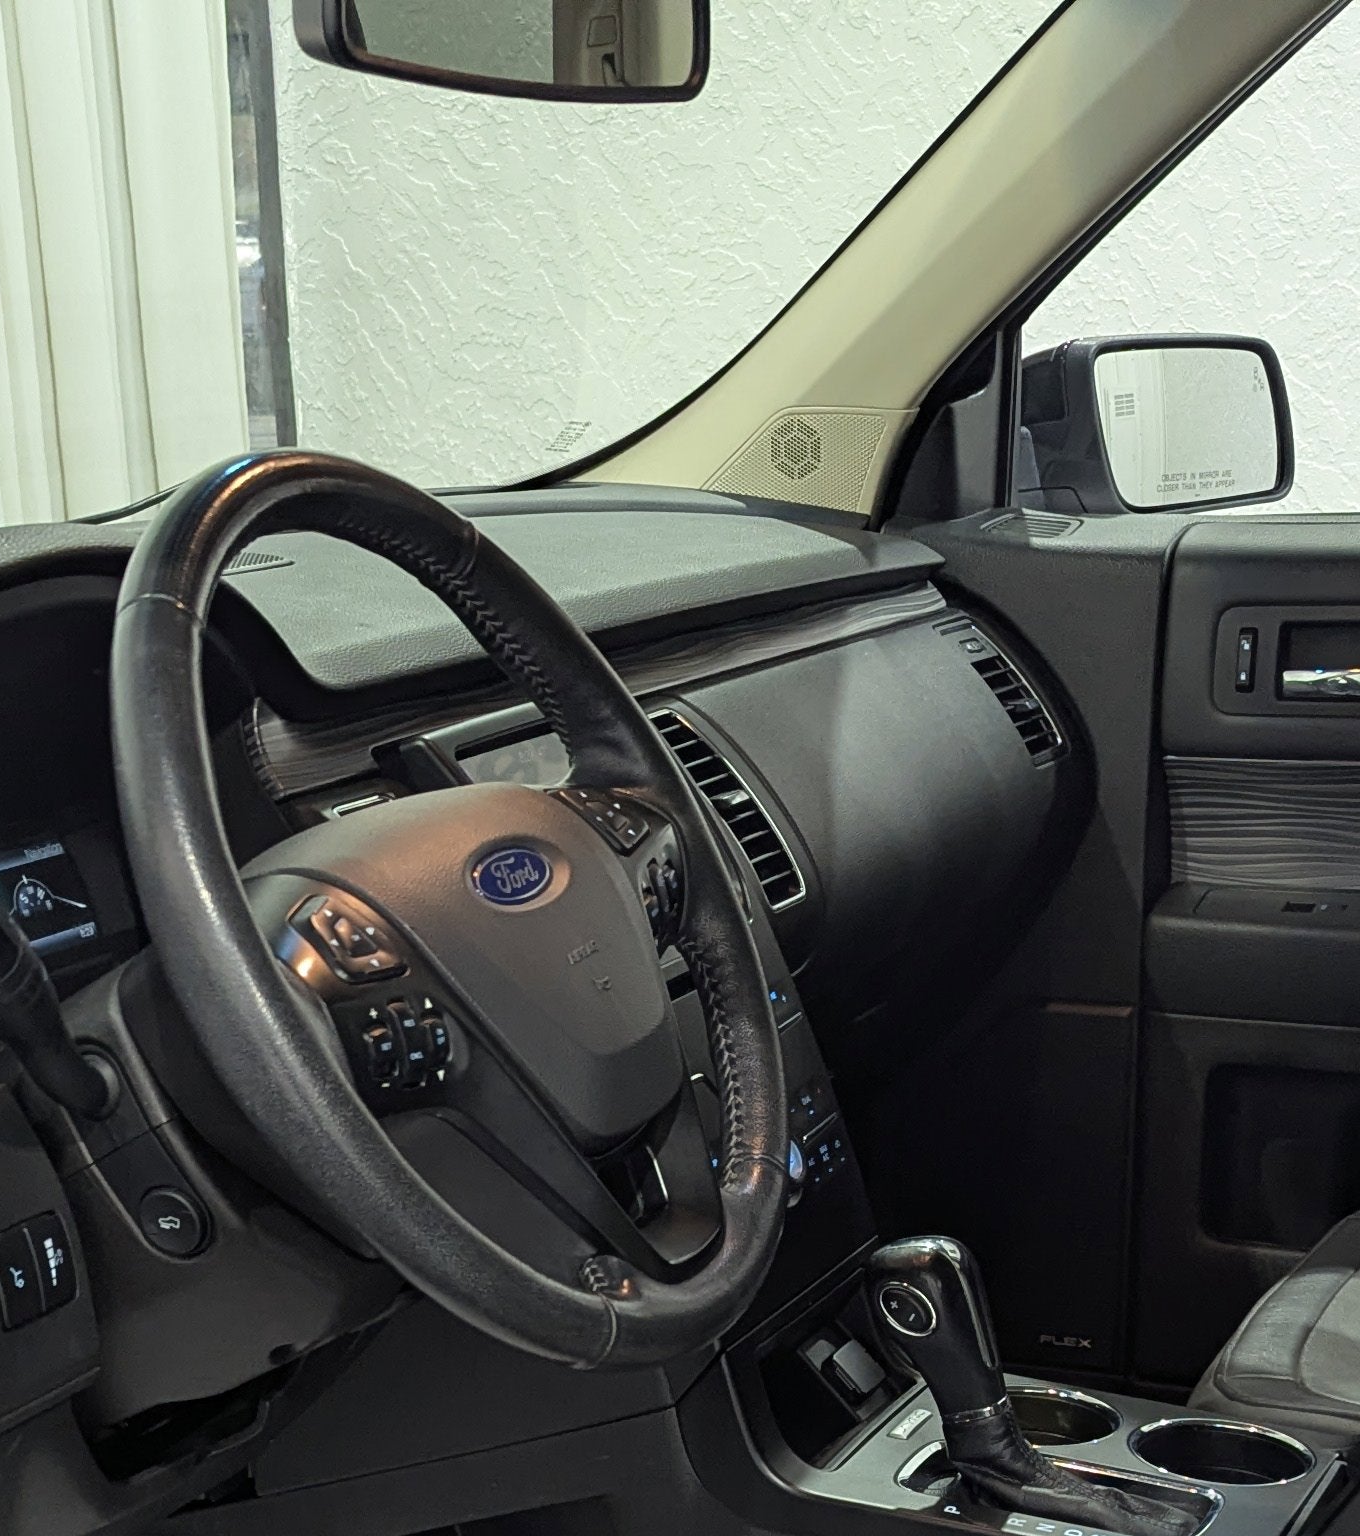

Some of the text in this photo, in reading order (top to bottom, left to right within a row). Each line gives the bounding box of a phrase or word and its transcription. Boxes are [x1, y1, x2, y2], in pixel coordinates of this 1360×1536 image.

[1162, 473, 1187, 482] OBJECTS
[1199, 470, 1219, 479] MIRROR
[1157, 484, 1180, 492] CLOSER
[1182, 482, 1196, 490] THAN
[1215, 480, 1235, 488] APPEAR
[490, 856, 538, 893] Ford
[1040, 1334, 1091, 1349] FLEX
[944, 1505, 961, 1515] P
[1006, 1517, 1027, 1527] R
[1035, 1522, 1056, 1533] N
